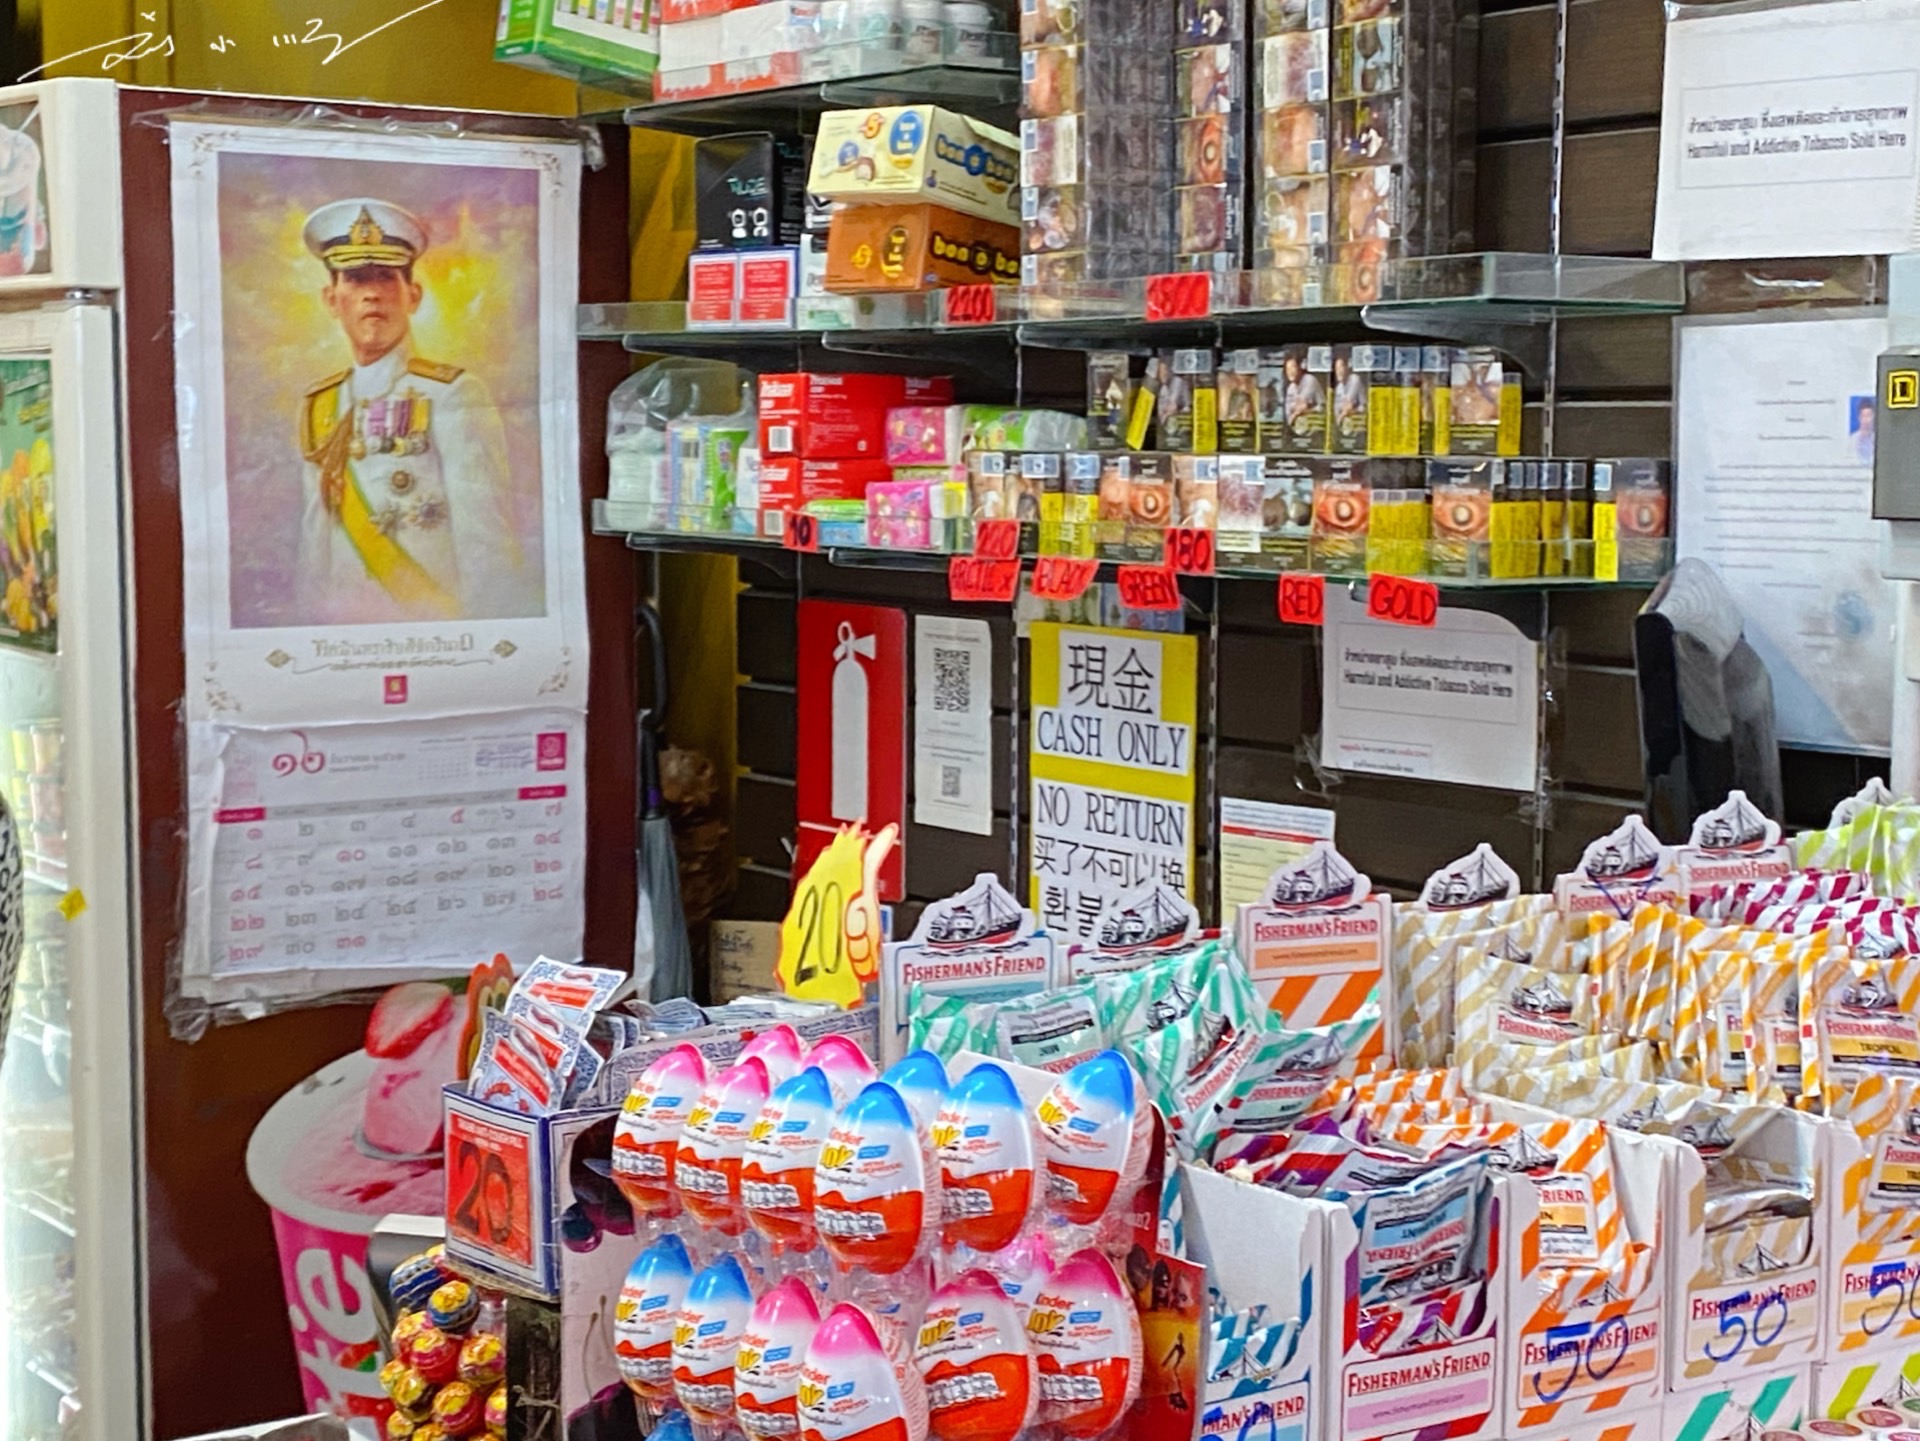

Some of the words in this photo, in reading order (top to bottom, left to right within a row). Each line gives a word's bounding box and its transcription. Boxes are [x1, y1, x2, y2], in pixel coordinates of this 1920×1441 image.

[1730, 142, 1750, 155] and
[1753, 138, 1800, 155] Addictive
[1803, 135, 1849, 150] Tobacco
[1850, 132, 1876, 149] Sold
[1878, 131, 1907, 147] Here
[994, 251, 1019, 275] bo
[790, 514, 811, 546] 10
[1168, 529, 1211, 571] 180
[1122, 570, 1176, 607] GREEN
[1281, 578, 1322, 618] RED
[1371, 579, 1437, 624] GOLD
[1067, 643, 1154, 715] 現金
[1343, 669, 1376, 685] Harmful
[1377, 672, 1393, 687] and
[1394, 673, 1432, 690] Addictive
[1433, 677, 1469, 693] Tobacco
[1470, 680, 1490, 695] Sold
[1491, 683, 1513, 698] Here
[1038, 711, 1102, 757] CASH
[1118, 720, 1186, 768] ONLY
[1037, 783, 1070, 827] NO
[1083, 790, 1185, 847] RETURN
[1033, 834, 1186, 900] 买了不可以换
[794, 881, 843, 987] 20
[1254, 918, 1332, 942] FISHERMAN'S
[1333, 916, 1378, 934] FRIEND
[903, 957, 992, 985] FISHERMAN'S
[993, 955, 1047, 977] FRIEND
[455, 1139, 514, 1246] 20
[1613, 1320, 1659, 1350] FRIEND
[1703, 1289, 1788, 1363] 50
[1348, 1361, 1441, 1397] FISHERMAN'S
[1441, 1351, 1491, 1378] FRIEND
[1532, 1314, 1630, 1404] 50
